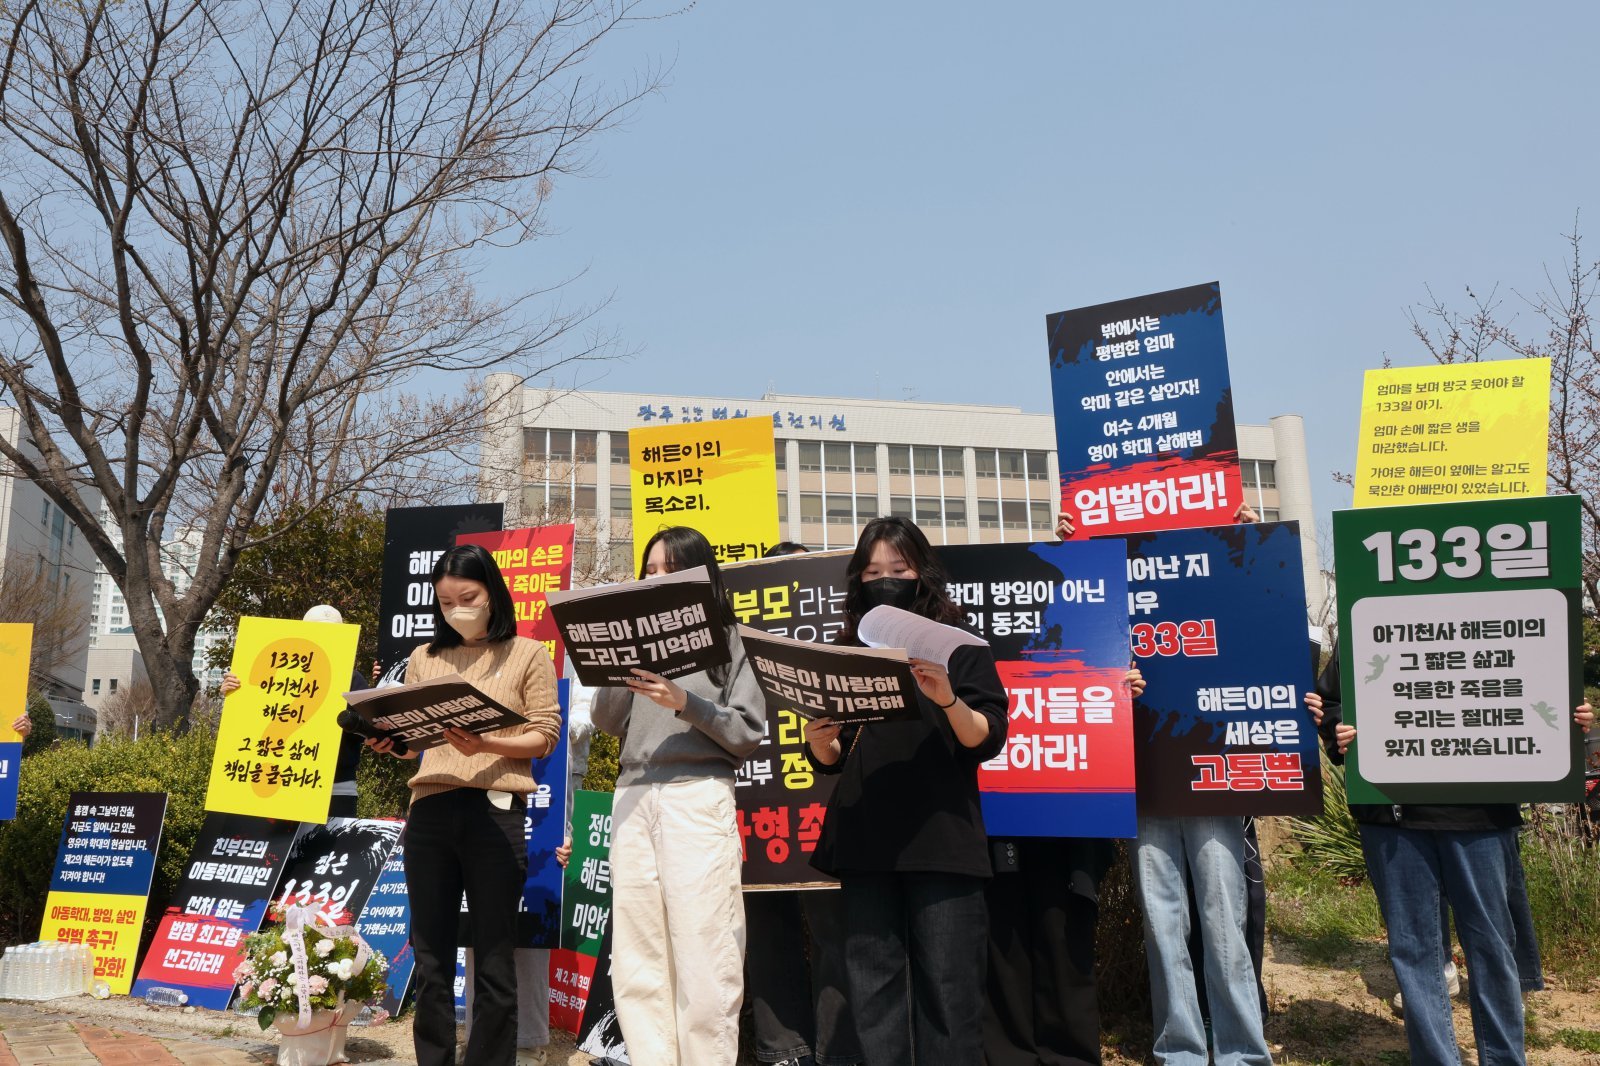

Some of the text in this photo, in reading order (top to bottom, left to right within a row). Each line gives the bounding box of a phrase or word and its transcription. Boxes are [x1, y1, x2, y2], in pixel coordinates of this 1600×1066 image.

[1101, 315, 1161, 340] 밖에서는
[1095, 333, 1175, 362] 평범한 엄마
[1105, 364, 1165, 387] 안에서는
[1377, 376, 1525, 396] 엄마를 보며 방긋 웃어야 할
[1081, 379, 1200, 412] 악마 같은 살인자!
[1376, 399, 1443, 413] 133일 아기.
[637, 404, 674, 423] 광주
[1103, 411, 1178, 437] 여수 4개월
[1374, 421, 1481, 437] 엄마 손에 짧은 생을
[642, 440, 722, 464] 해든이의
[1087, 430, 1203, 463] 영아 학대 살해범
[1372, 440, 1448, 455] 마감했습니다.
[643, 467, 704, 489] 마지막
[1370, 462, 1530, 479] 가여운 해든이 옆에는 알고도
[1074, 470, 1228, 526] 엄벌하라!
[1368, 481, 1530, 497] 묵인한 아빠만이 있었습니다.
[645, 493, 710, 515] 목소리.
[491, 544, 564, 569] 마의 손은
[1361, 520, 1550, 583] 133일
[1184, 553, 1210, 578] 지
[513, 572, 561, 594] 죽이는
[990, 580, 1055, 606] 방임이
[1061, 578, 1105, 603] 아닌
[565, 602, 707, 643] 해든아 사랑해
[991, 610, 1041, 636] 동조!
[1372, 618, 1546, 644] 아기천사 해든이의
[576, 645, 641, 666] 그리고
[642, 627, 714, 662] 기억해
[1129, 618, 1218, 658] 33일
[270, 651, 314, 673] 133일
[1399, 649, 1515, 671] 그 짧은 삶과
[754, 655, 900, 693] 해든아 사랑해
[260, 676, 319, 698] 아기천사
[762, 676, 905, 713] 그리고 기억해
[1196, 684, 1297, 712] 해든이의
[1392, 678, 1524, 700] 억울한 죽음을
[262, 703, 306, 724] 해든이.
[423, 694, 486, 718] 사랑해
[1005, 686, 1115, 724] 자들을
[391, 723, 445, 743] 그리고
[442, 706, 504, 729] 기억해
[1394, 708, 1525, 729] 우리는 절대로
[1224, 719, 1300, 746] 세상은
[238, 736, 320, 761] 그 짧은 삶에
[1384, 736, 1542, 757] 잊지 않겠습니다.
[223, 760, 323, 789] 책임을 묻습니다.
[1190, 753, 1304, 791] 고통뿐
[74, 805, 135, 818] 홈캠 속 그날의 진실,
[71, 822, 135, 834] 지금도 일어나고 있는
[67, 838, 147, 851] 영유아 학대의 현실입니다.
[211, 837, 270, 860] 친부모의
[63, 854, 133, 867] 제2의 해든이가 없도록
[314, 851, 349, 876] 짧은
[60, 870, 105, 884] 지켜야 합니다!
[188, 861, 273, 887] 아동학대살인
[580, 857, 610, 894] 해든
[51, 906, 136, 925] 아동학대, 방임, 살인
[184, 896, 245, 920] 선처 없는
[85, 928, 118, 951] 촉구!
[167, 920, 243, 948] 법정 최고형
[93, 957, 127, 979] 강화!
[162, 948, 225, 975] 선고하라!
